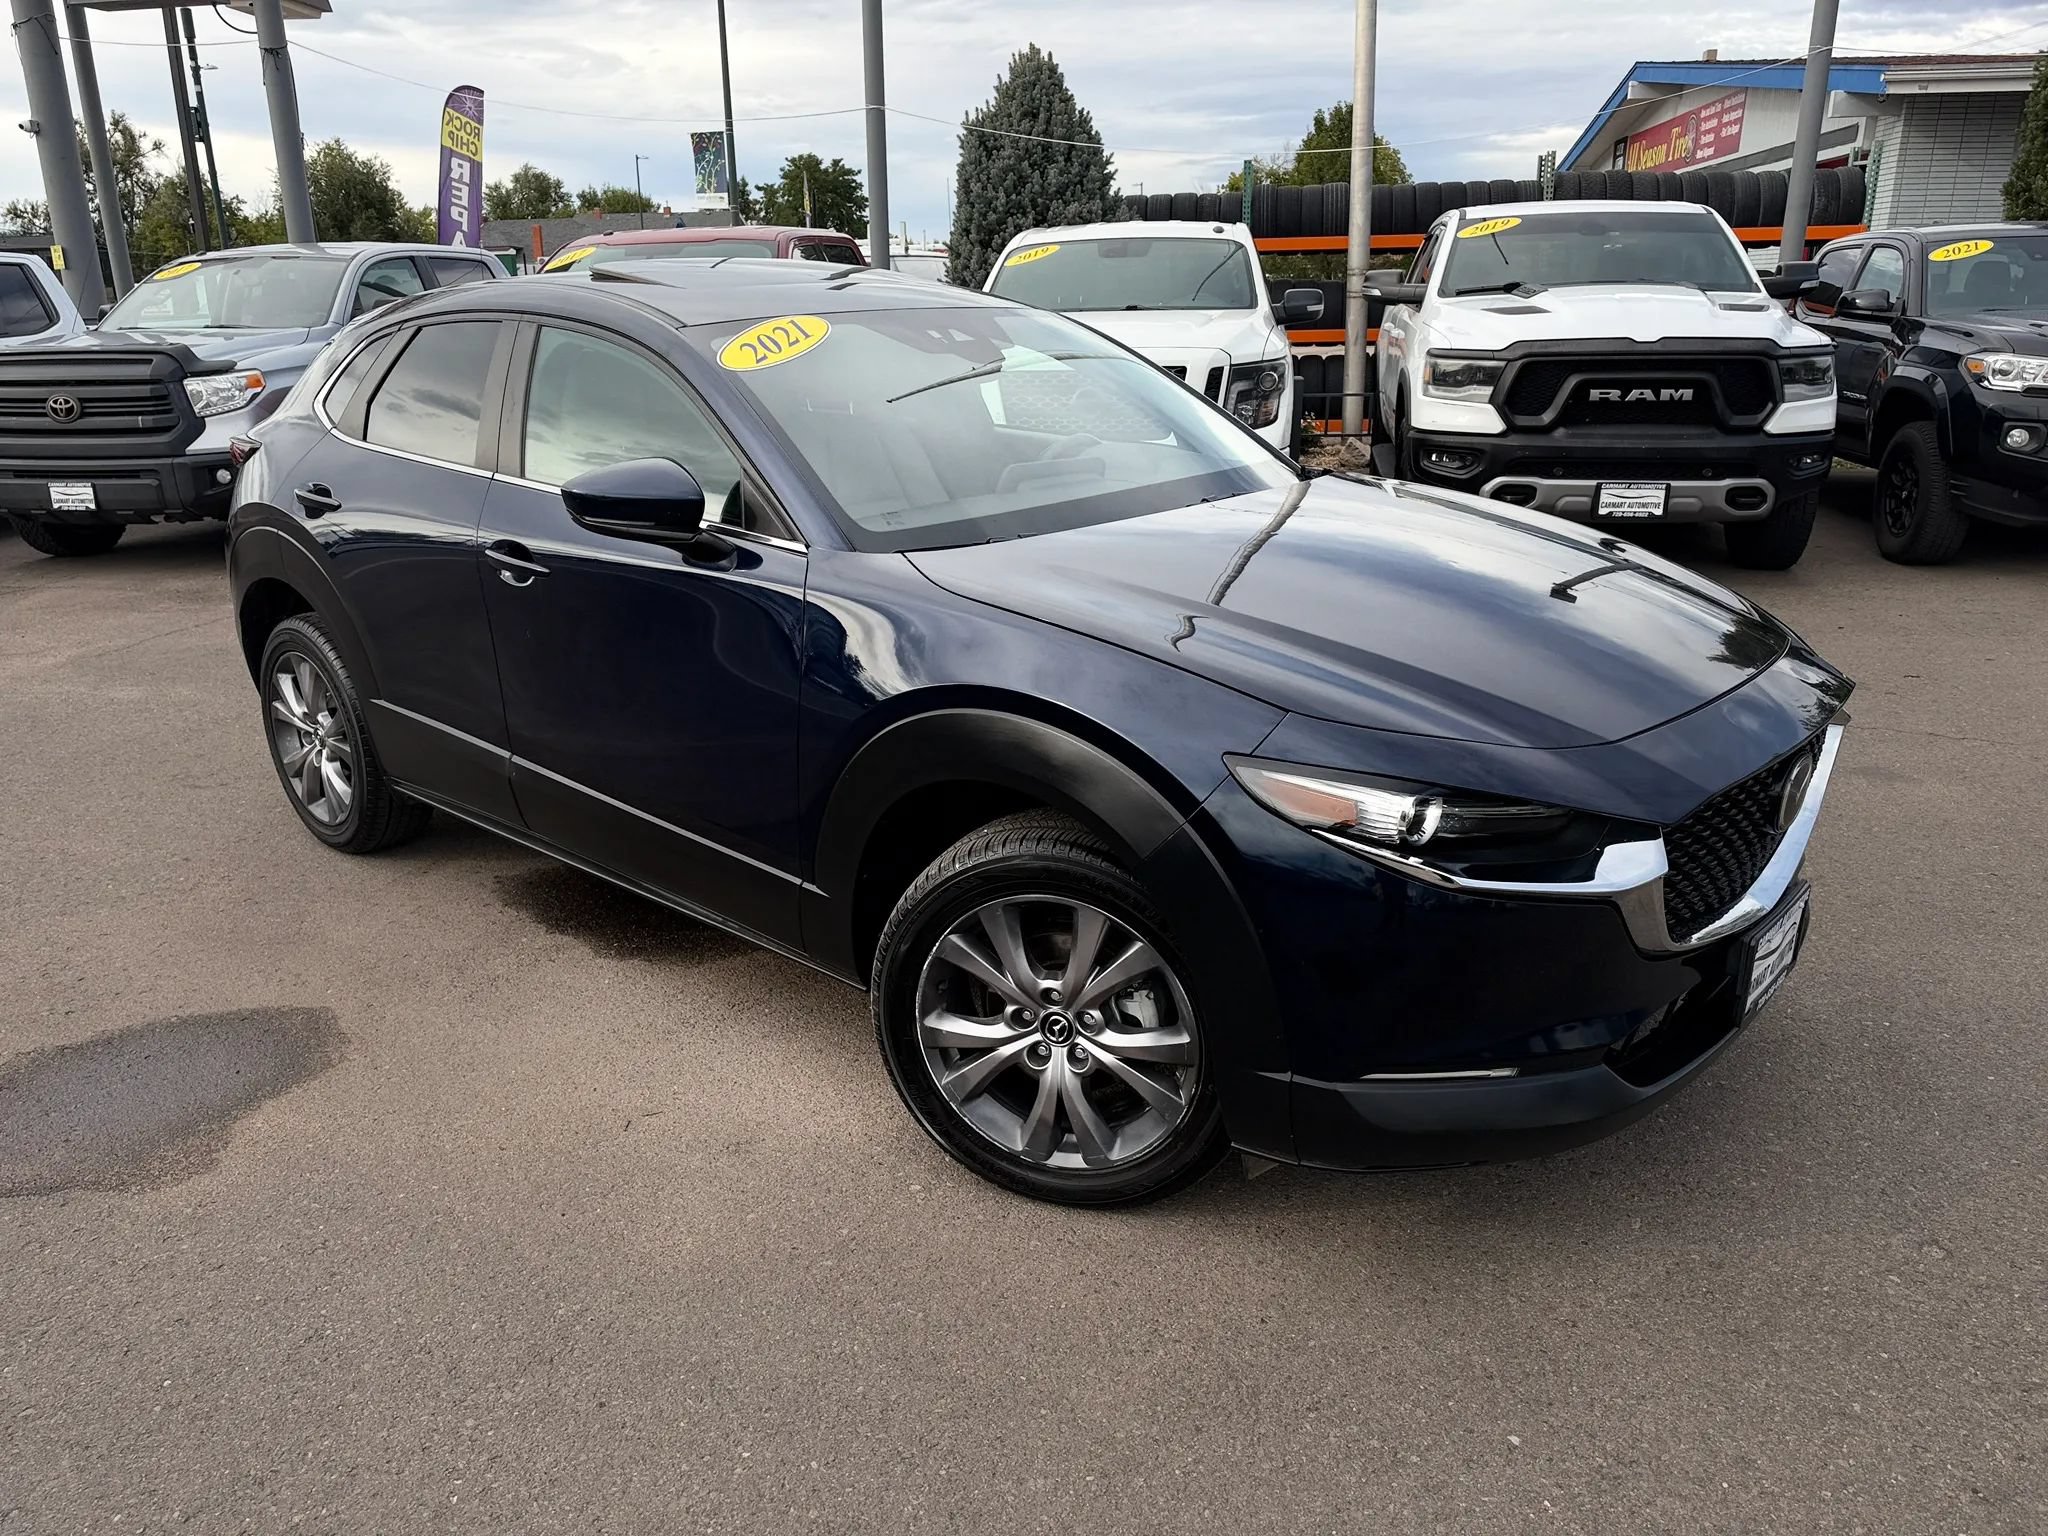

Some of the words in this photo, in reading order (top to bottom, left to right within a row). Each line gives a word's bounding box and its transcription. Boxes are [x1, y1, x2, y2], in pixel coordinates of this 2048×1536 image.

[1638, 140, 1668, 171] Season
[1469, 219, 1511, 236] 2019
[1015, 246, 1050, 263] 2019
[1942, 242, 1980, 259] 2021
[739, 319, 814, 365] 2021
[1588, 388, 1694, 402] RAM
[1600, 501, 1627, 509] CARMART
[1627, 501, 1662, 510] AUTOMOTIVE
